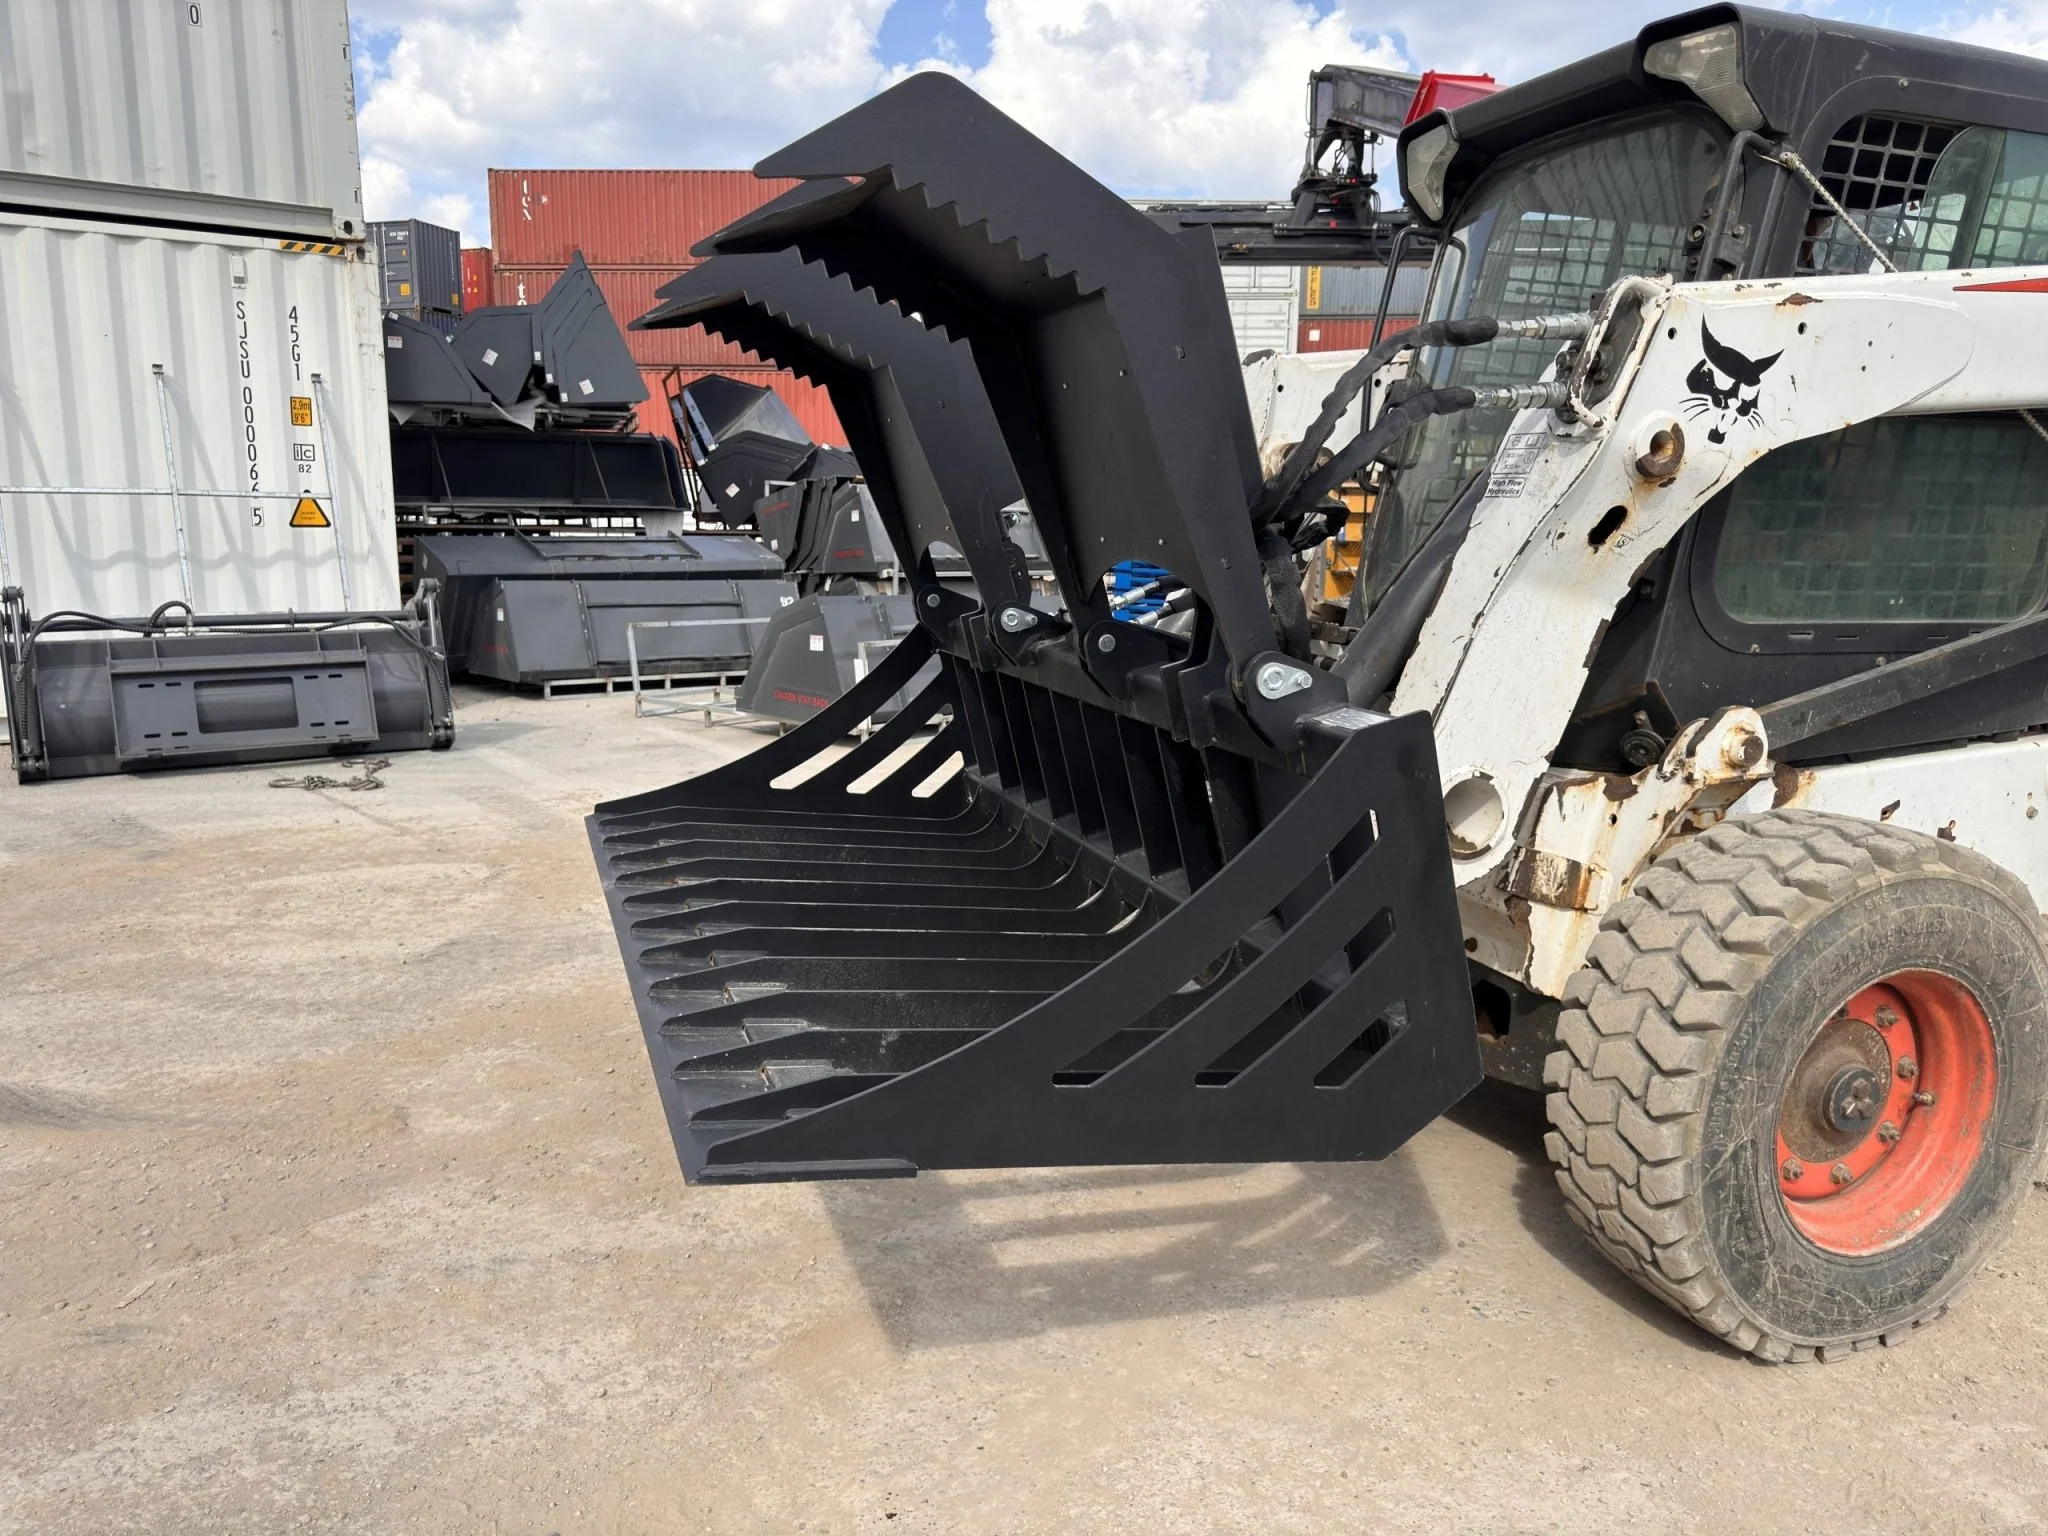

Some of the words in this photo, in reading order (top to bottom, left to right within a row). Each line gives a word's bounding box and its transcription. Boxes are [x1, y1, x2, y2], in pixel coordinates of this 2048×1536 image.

[236, 300, 250, 379] SJSU
[289, 305, 301, 381] 45G1
[292, 399, 310, 411] 2.9m
[298, 464, 312, 474] 82
[1491, 479, 1506, 488] High
[1507, 479, 1524, 487] Flow
[774, 690, 795, 702] DANGER
[798, 693, 811, 704] STAY
